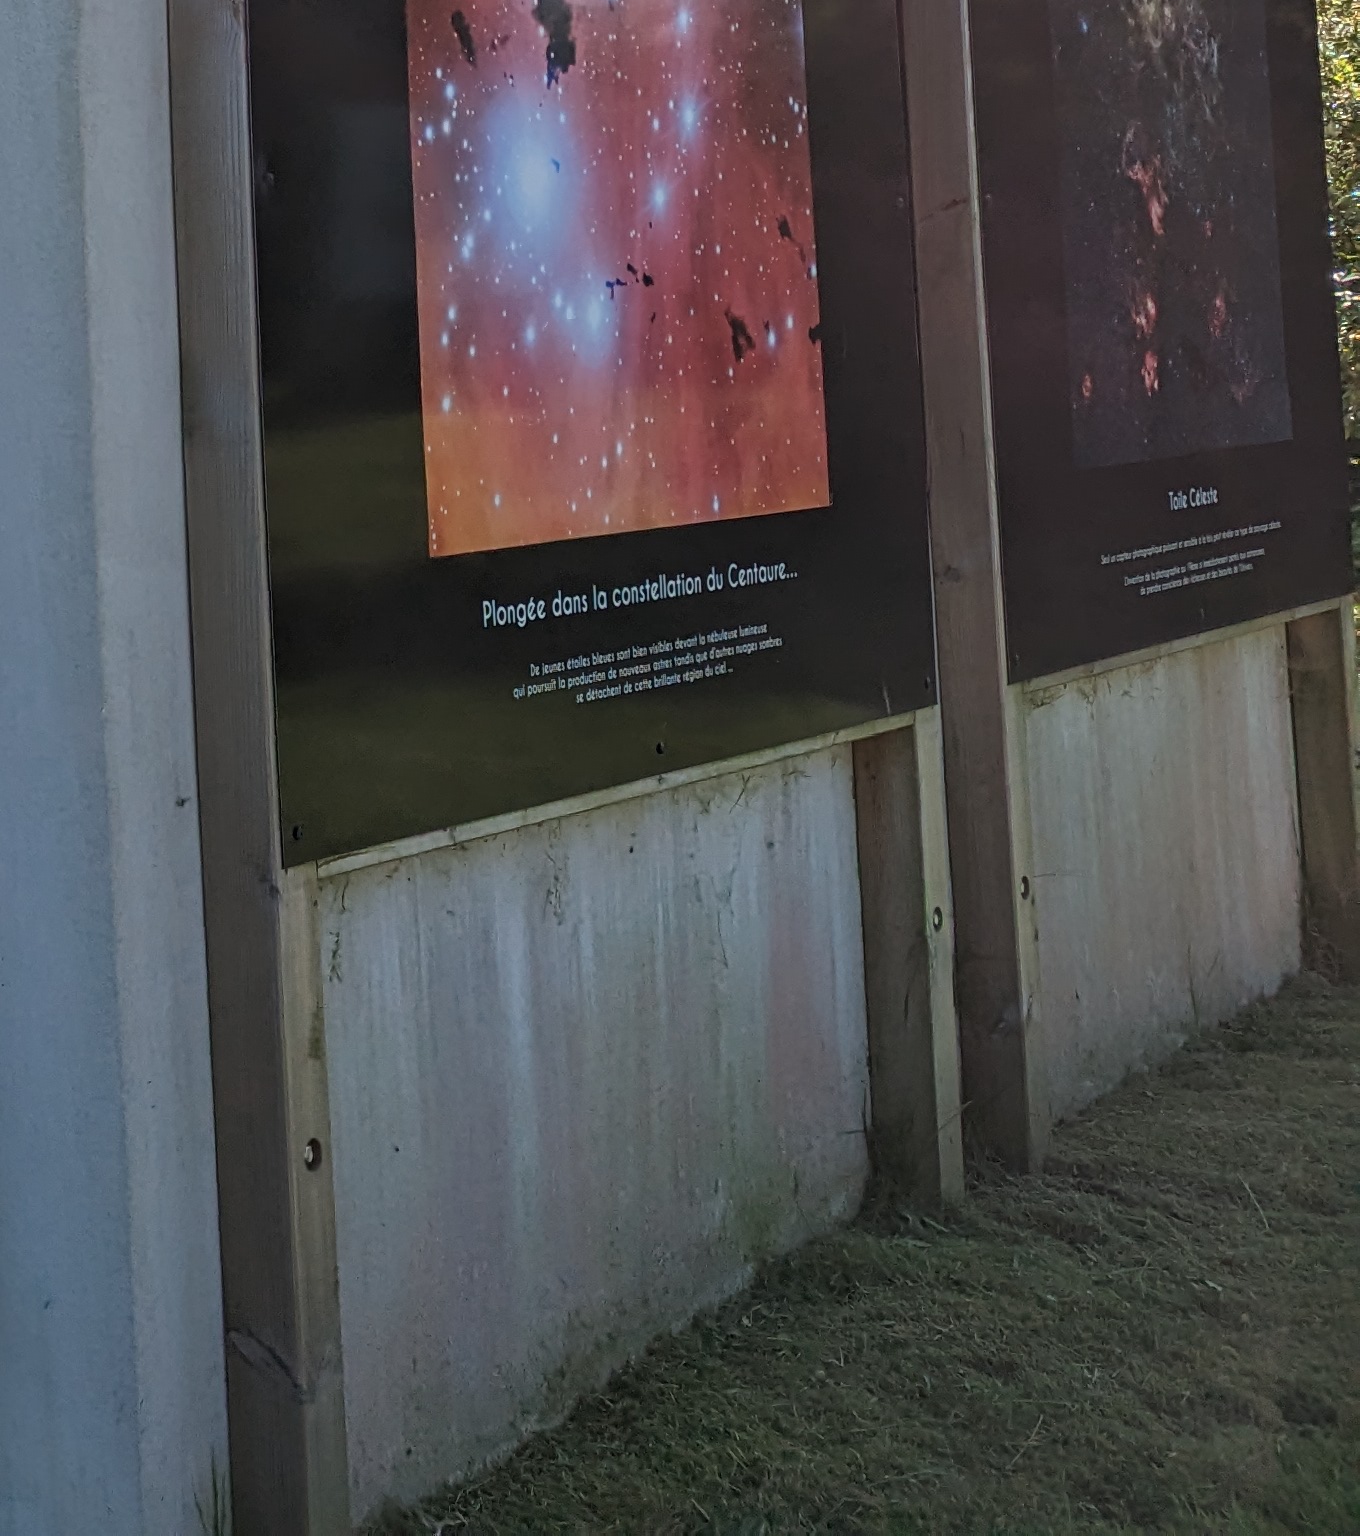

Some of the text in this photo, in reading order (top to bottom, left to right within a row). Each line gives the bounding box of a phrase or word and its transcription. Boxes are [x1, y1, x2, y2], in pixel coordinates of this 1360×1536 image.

[1168, 486, 1218, 510] Toile Céleste
[482, 562, 797, 627] Plongée dans la constellation du Centaure...
